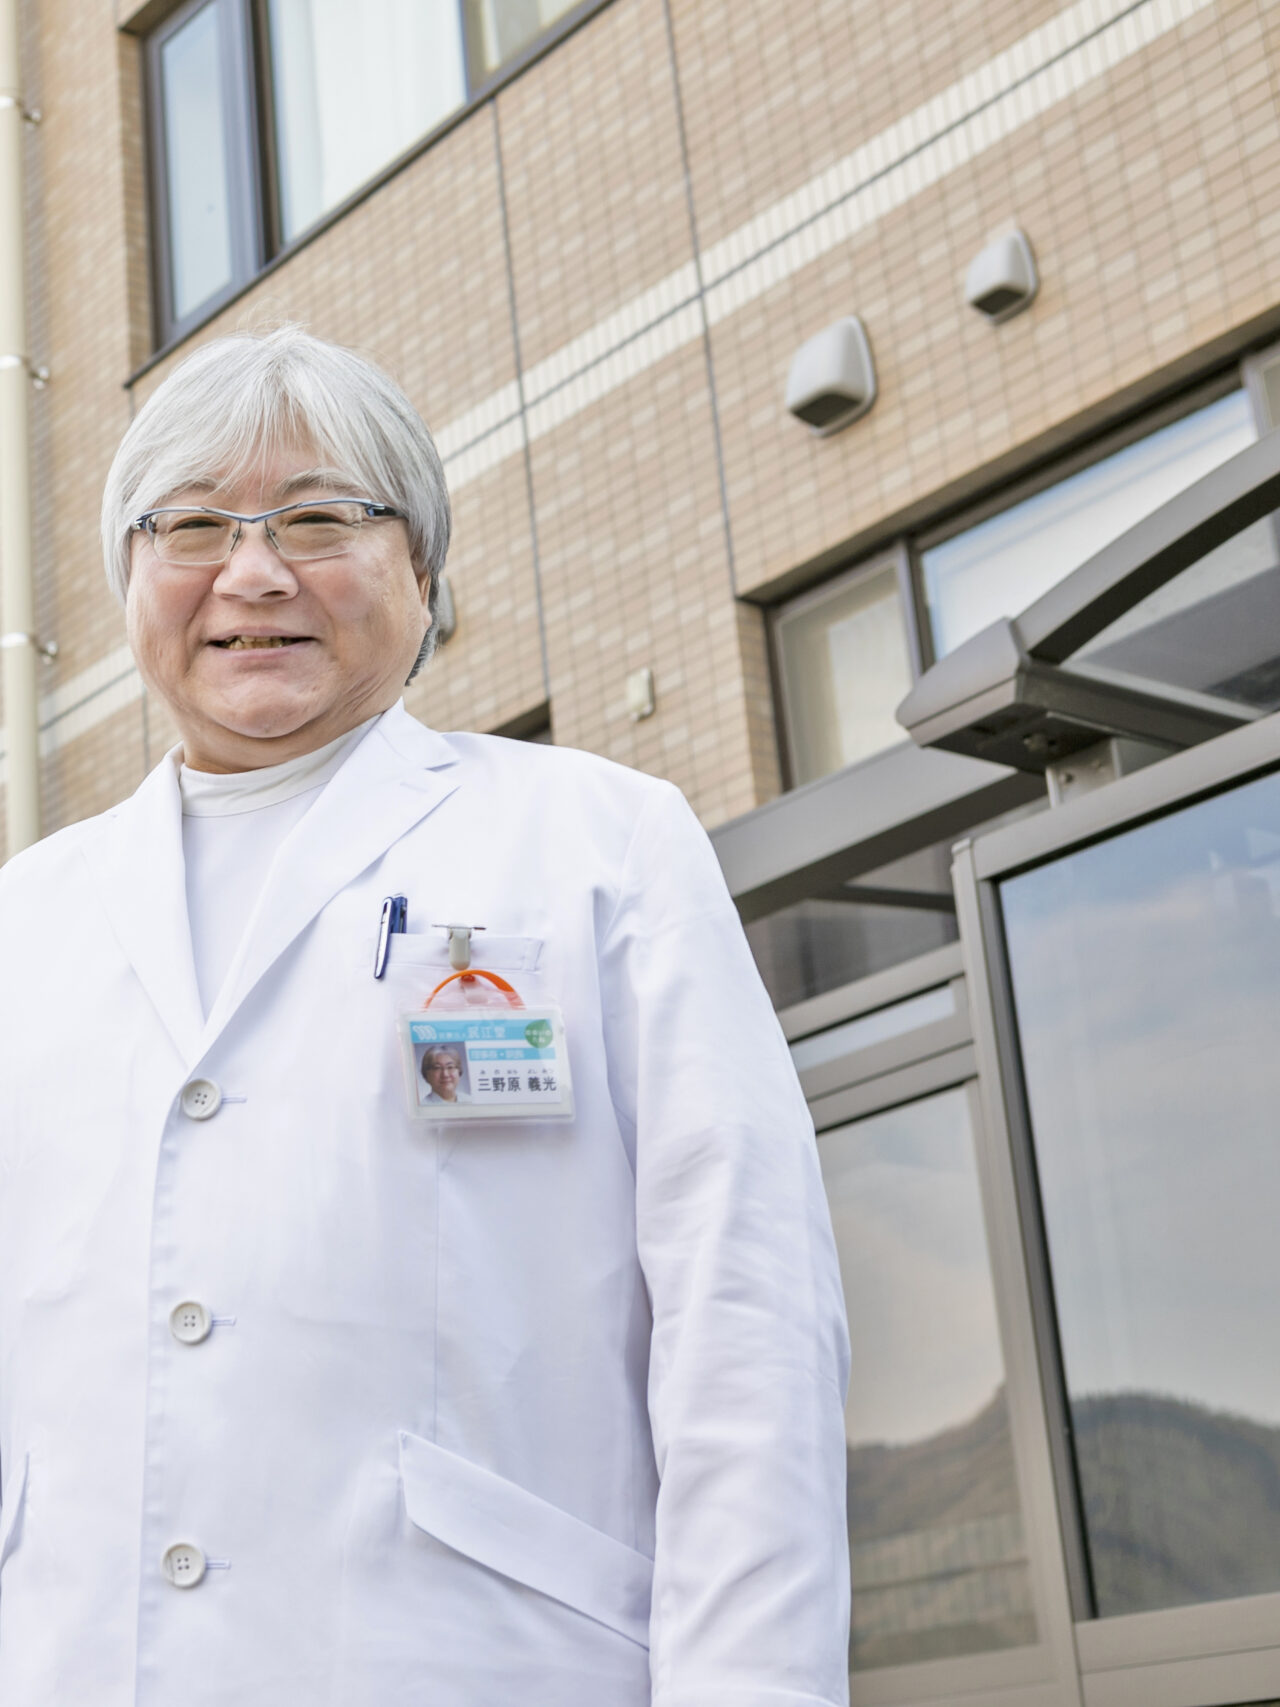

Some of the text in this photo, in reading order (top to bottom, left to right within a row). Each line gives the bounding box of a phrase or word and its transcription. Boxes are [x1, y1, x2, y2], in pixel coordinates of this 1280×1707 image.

[478, 1077, 557, 1092] 三野原 義光
